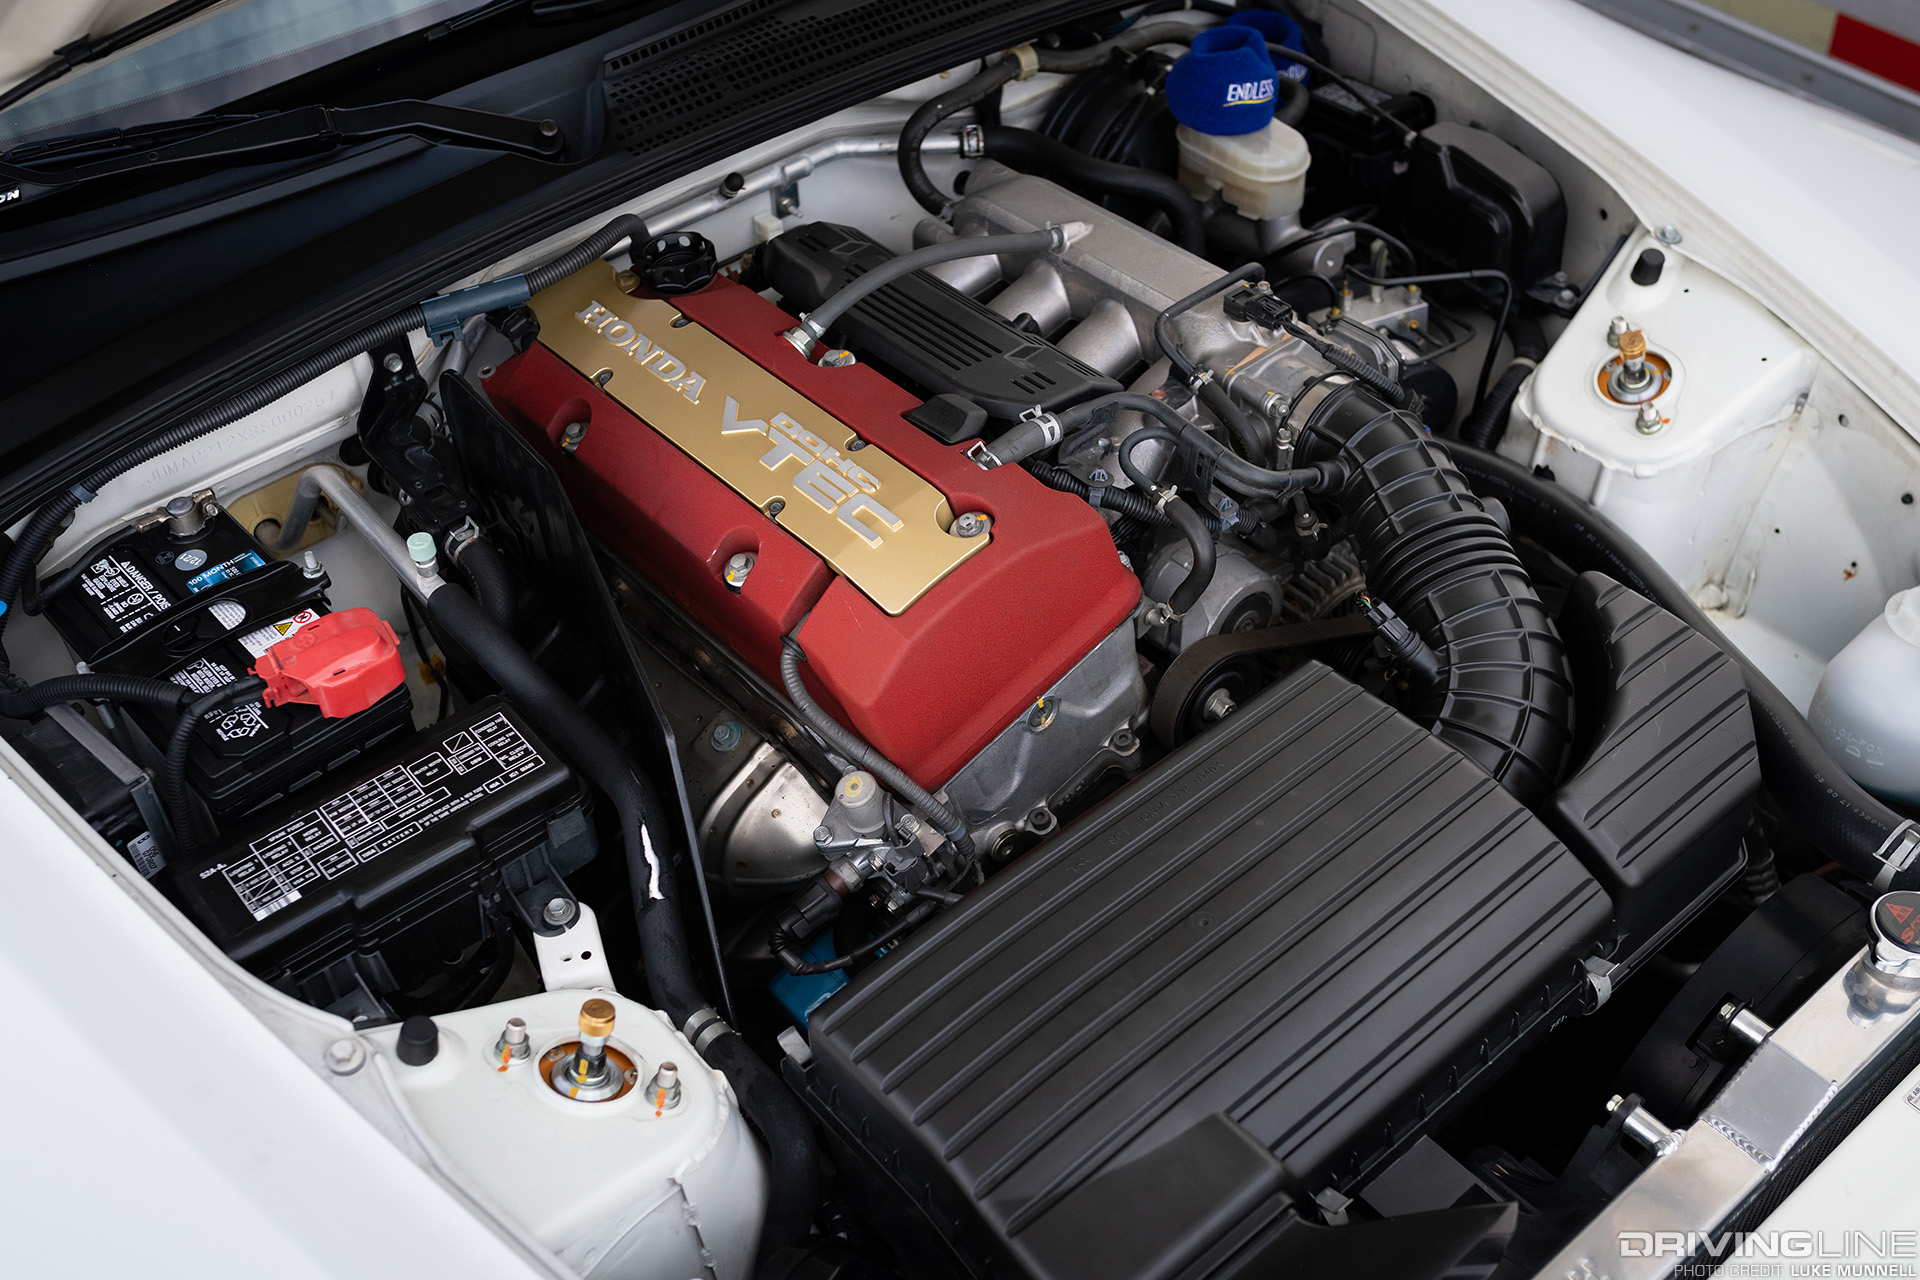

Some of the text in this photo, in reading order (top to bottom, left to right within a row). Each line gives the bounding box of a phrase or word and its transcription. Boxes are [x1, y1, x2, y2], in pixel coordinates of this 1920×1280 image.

[1227, 78, 1274, 101] ENDLESS
[574, 300, 707, 405] HONDA
[770, 412, 881, 493] DOHC
[721, 396, 904, 549] VTEC
[123, 564, 155, 592] DANGER
[188, 576, 203, 585] 100
[201, 559, 234, 578] MONTH
[497, 737, 511, 747] RELAY
[508, 750, 525, 761] RELAY
[398, 806, 416, 818] SPARE
[416, 797, 434, 808] FUSES
[267, 820, 305, 842] SPARE FUSES
[304, 830, 322, 842] RELAY
[381, 827, 415, 847] BATTERY
[312, 837, 334, 851] HAZARD
